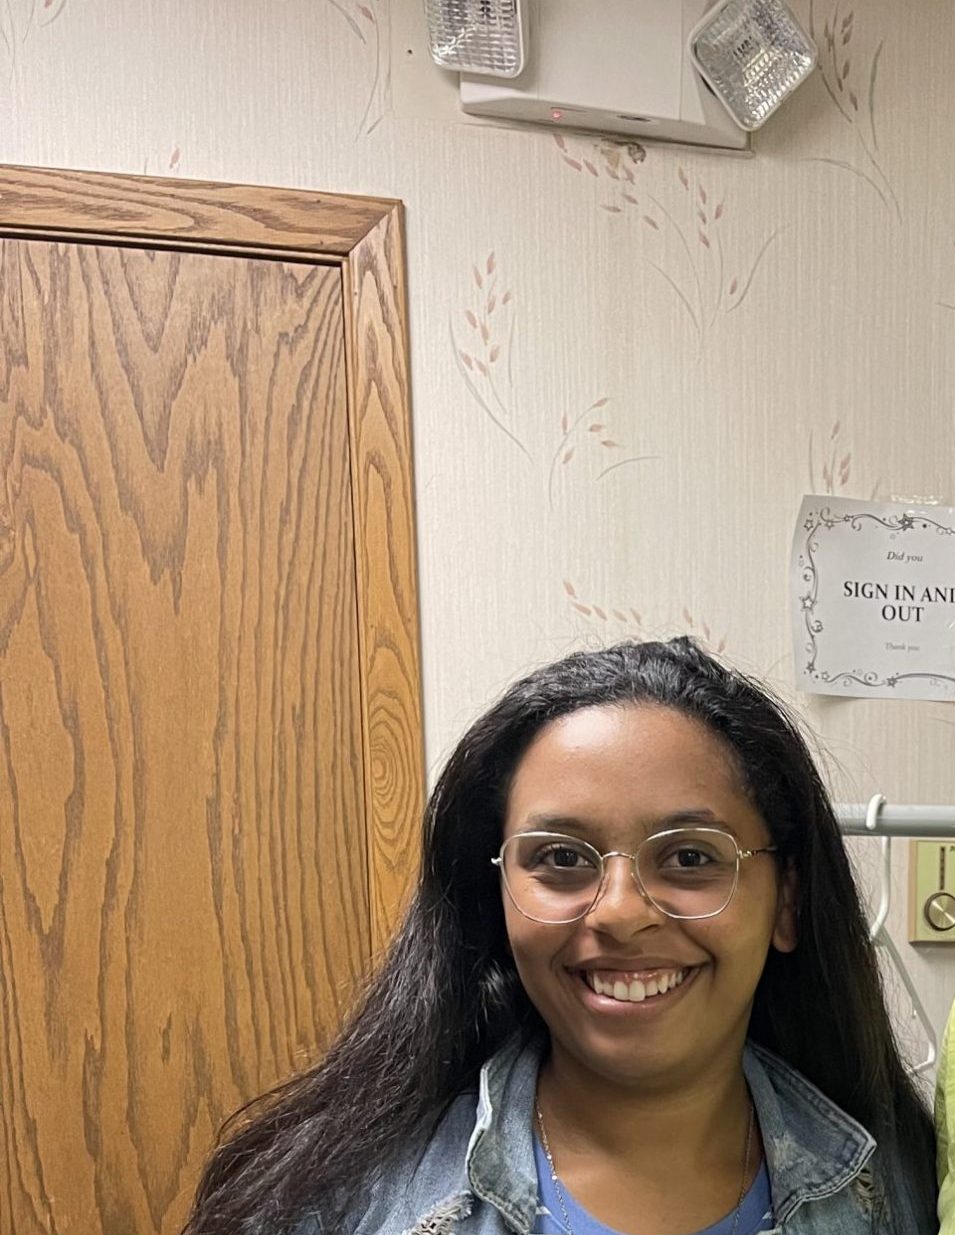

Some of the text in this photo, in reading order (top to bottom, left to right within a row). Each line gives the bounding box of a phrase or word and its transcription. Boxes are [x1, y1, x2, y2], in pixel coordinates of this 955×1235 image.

[887, 551, 923, 563] Did you
[843, 581, 888, 600] SIGN
[895, 585, 915, 601] IN
[882, 605, 925, 622] OUT
